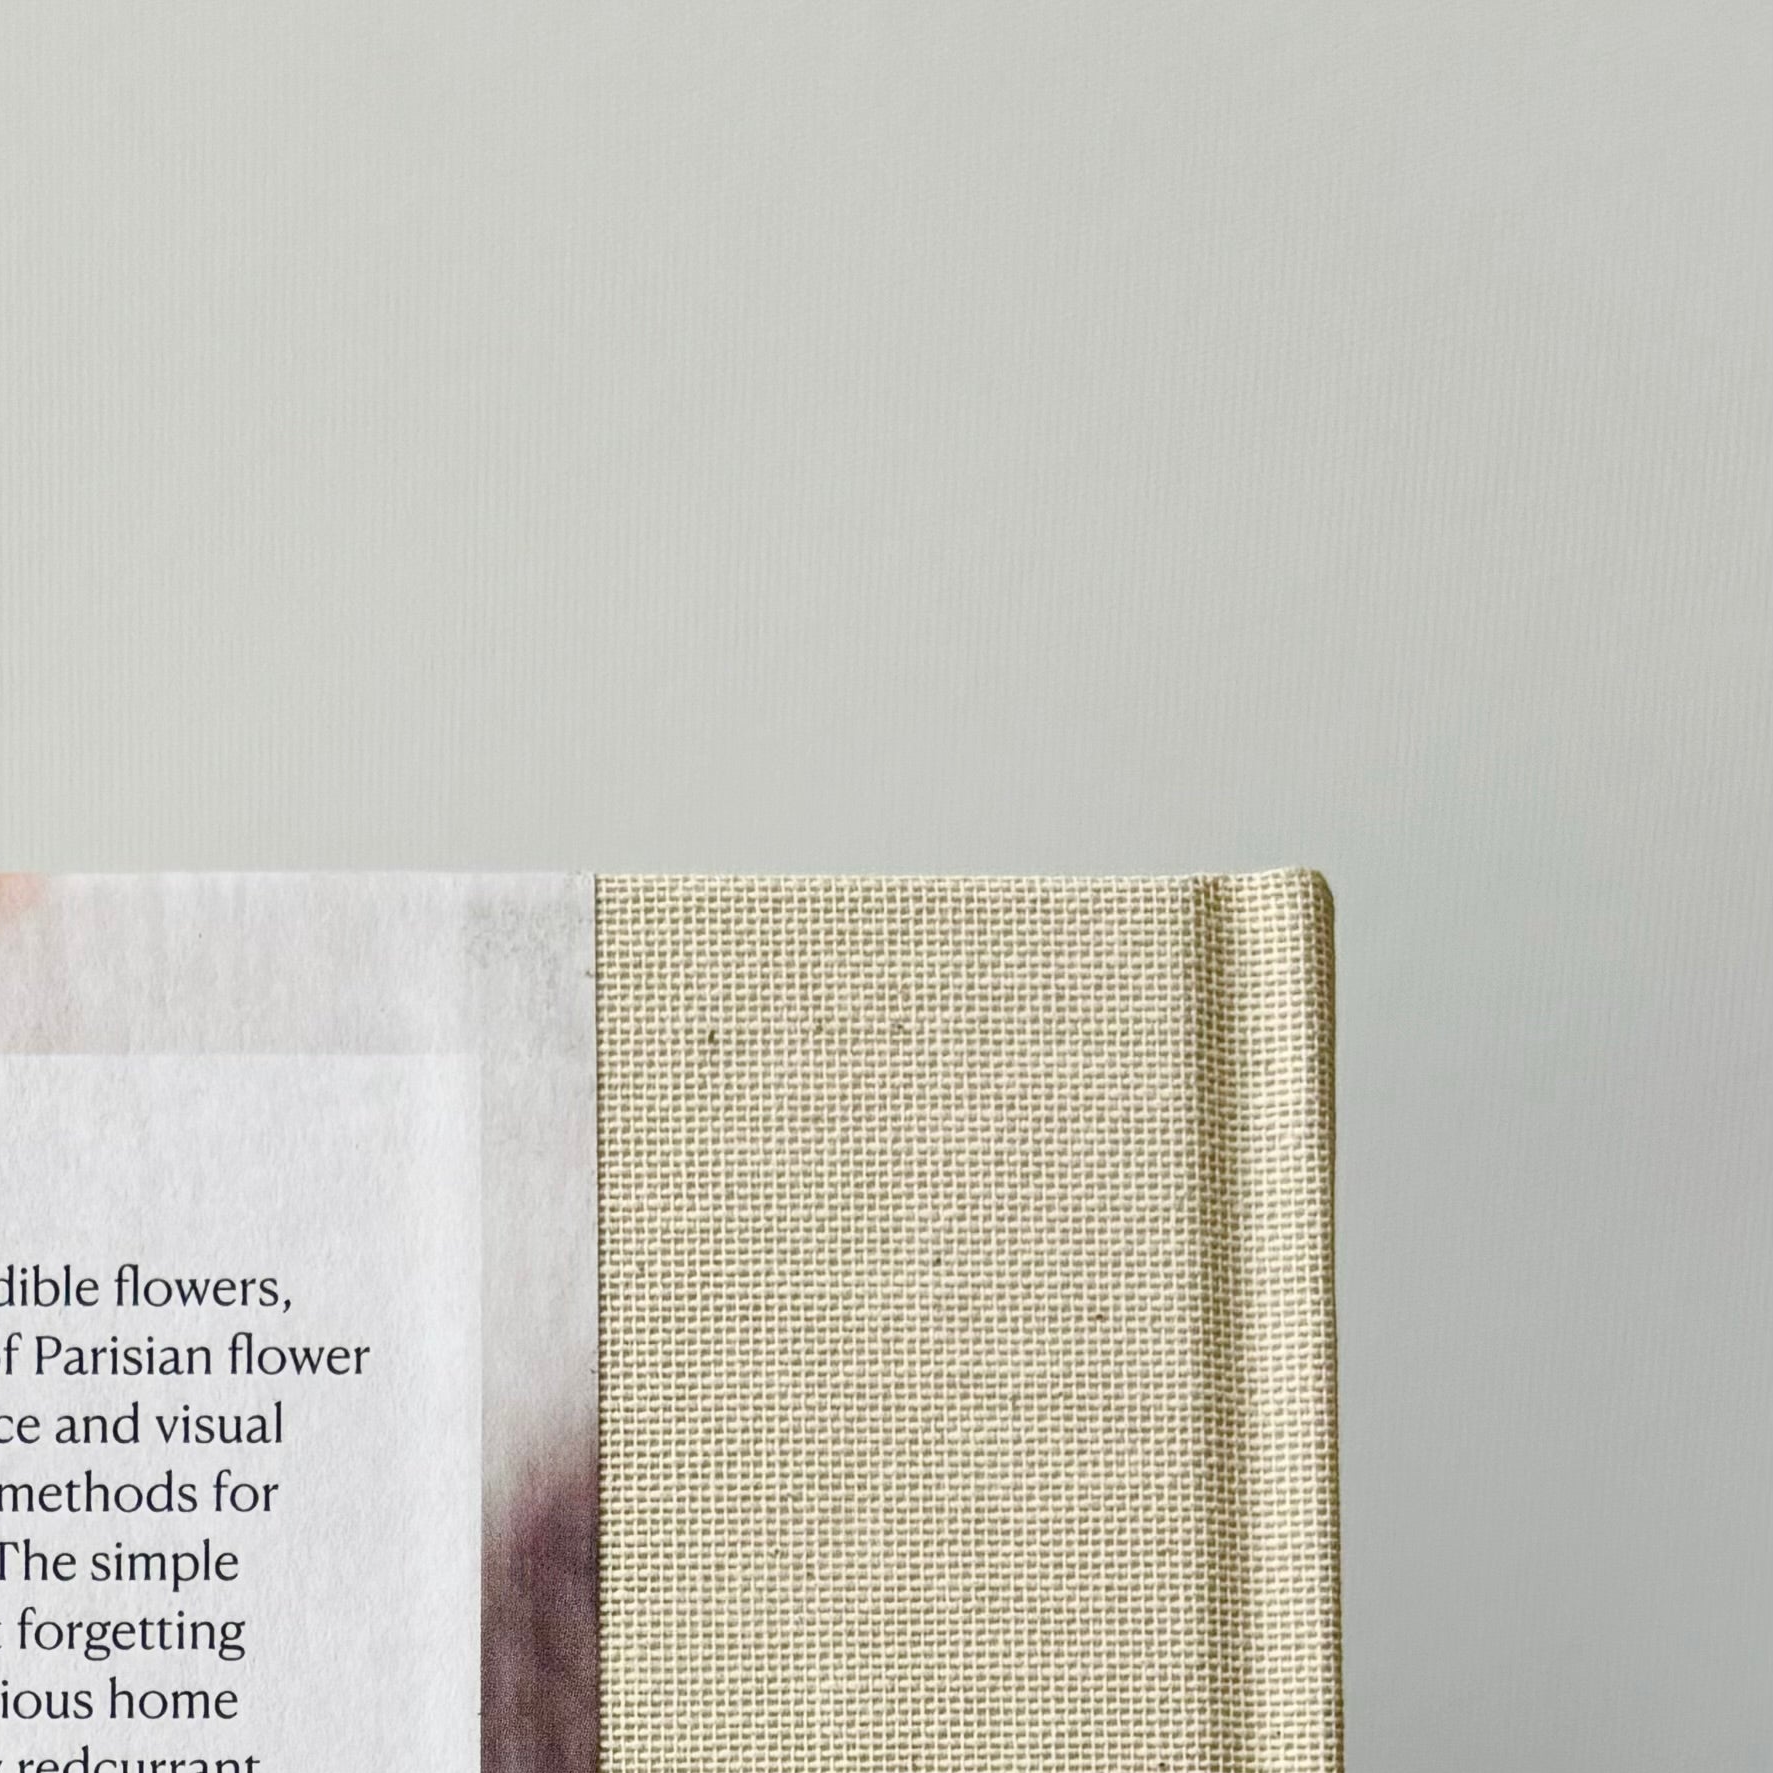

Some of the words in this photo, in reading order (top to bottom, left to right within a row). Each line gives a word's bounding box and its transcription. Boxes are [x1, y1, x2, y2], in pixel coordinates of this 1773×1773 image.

[113, 1262, 292, 1314] flowers,
[35, 1334, 212, 1376] Parisian
[227, 1331, 371, 1376] flower
[55, 1400, 141, 1445] and
[155, 1399, 283, 1445] visual
[212, 1468, 280, 1513] for
[90, 1537, 239, 1593] simple
[16, 1605, 246, 1662] forgetting
[108, 1675, 239, 1720] home
